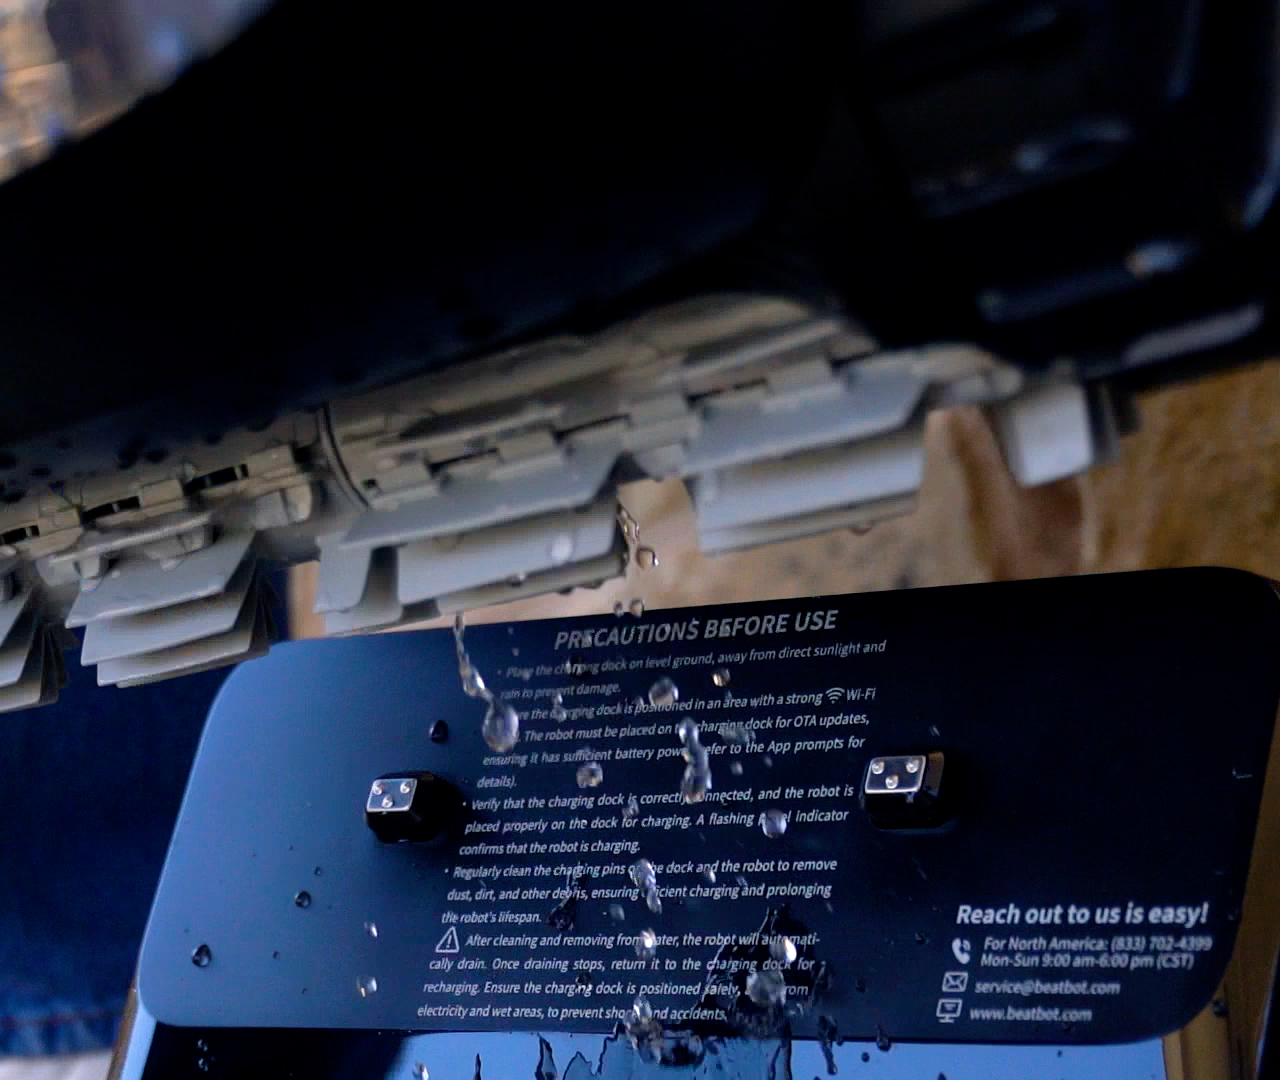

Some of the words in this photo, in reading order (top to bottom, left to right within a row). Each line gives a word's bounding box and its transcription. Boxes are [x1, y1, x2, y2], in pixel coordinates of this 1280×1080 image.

[553, 620, 700, 650] PRECAUTIONS
[704, 613, 790, 639] BEFORE
[795, 609, 839, 632] USE
[601, 658, 628, 671] dock
[629, 660, 643, 669] on
[645, 656, 671, 668] level
[672, 652, 715, 669] ground,
[717, 650, 747, 665] away
[749, 648, 776, 661] from
[778, 645, 811, 658] direct
[813, 642, 860, 657] sunlight
[863, 640, 887, 653] and
[576, 683, 620, 696] damage.
[596, 704, 622, 715] dock
[624, 702, 633, 714] is
[695, 695, 705, 709] in
[707, 700, 721, 709] an
[723, 698, 747, 708] area
[750, 694, 773, 707] with
[776, 697, 784, 705] a
[785, 692, 823, 706] strong
[847, 687, 876, 701] Wi-Fi
[524, 730, 542, 742] The
[544, 729, 573, 741] robot
[575, 728, 602, 740] must
[604, 726, 618, 738] be
[619, 724, 656, 739] placed
[657, 725, 672, 735] on
[745, 716, 772, 730] dock
[774, 715, 792, 729] for
[793, 716, 817, 728] OTA
[819, 713, 870, 729] updates,
[530, 753, 538, 764] it
[542, 752, 560, 763] has
[563, 748, 611, 761] sufficient
[615, 747, 654, 761] battery
[730, 743, 742, 754] to
[745, 741, 764, 753] the
[767, 740, 791, 757] App
[794, 738, 844, 754] prompts
[847, 735, 866, 749] for
[476, 775, 517, 789] details).
[471, 798, 501, 812] Verify
[503, 797, 524, 809] that
[528, 796, 546, 808] the
[548, 795, 594, 810] charging
[597, 793, 624, 806] dock
[628, 793, 637, 804] is
[640, 791, 687, 806] correctly
[758, 788, 780, 800] and
[784, 786, 804, 798] the
[807, 785, 840, 798] robot
[843, 784, 854, 797] is
[464, 820, 500, 835] placed
[502, 819, 548, 834] properly
[551, 821, 565, 830] on
[569, 818, 588, 829] the
[591, 816, 618, 828] dock
[621, 815, 638, 828] for
[641, 814, 692, 829] charging.
[695, 814, 705, 825] A
[709, 812, 755, 827] flashing
[795, 809, 849, 822] indicator
[459, 843, 504, 855] confirms
[506, 842, 527, 854] that
[529, 841, 547, 853] the
[549, 840, 578, 853] robot
[580, 841, 589, 852] is
[590, 839, 640, 854] charging.
[453, 866, 501, 880] Regularly
[503, 865, 531, 877] clean
[533, 864, 551, 876] the
[553, 863, 600, 878] charging
[602, 863, 626, 877] pins
[666, 860, 693, 874] dock
[696, 860, 718, 872] and
[721, 860, 740, 872] the
[742, 859, 774, 872] robot
[777, 861, 790, 872] to
[792, 860, 837, 871] remove
[447, 889, 472, 902] dust,
[475, 888, 496, 901] dirt,
[499, 888, 519, 899] and
[521, 887, 551, 899] other
[552, 887, 588, 900] debris,
[591, 887, 639, 901] ensuring
[689, 884, 739, 899] charging
[741, 884, 765, 896] and
[766, 882, 832, 899] prolonging
[441, 911, 459, 923] the
[460, 911, 497, 923] robot's
[499, 910, 542, 925] lifespan.
[956, 903, 1020, 924] Reach
[1024, 904, 1063, 924] out
[1067, 904, 1090, 924] to
[1095, 906, 1121, 924] us
[1125, 900, 1144, 924] is
[1148, 901, 1209, 928] easy!
[465, 934, 490, 946] After
[493, 934, 538, 949] cleaning
[540, 934, 562, 946] and
[563, 935, 614, 949] removing
[682, 934, 701, 945] the
[704, 933, 737, 945] robot
[739, 932, 759, 945] will
[983, 936, 1007, 950] For
[1008, 936, 1048, 950] North
[1049, 936, 1109, 950] America:
[429, 958, 454, 972] cally
[457, 958, 486, 970] drain.
[492, 958, 520, 970] Once
[524, 957, 569, 973] draining
[572, 958, 606, 972] stops,
[610, 959, 646, 970] return
[651, 958, 661, 970] it
[664, 959, 677, 970] to
[682, 958, 701, 970] the
[762, 957, 791, 970] dock
[796, 957, 815, 970] for
[980, 953, 1039, 967] Mon-Sun
[1041, 953, 1071, 967] 9:00
[1129, 956, 1154, 971] pm
[1156, 953, 1195, 970] (CST)
[423, 982, 480, 996] recharging.
[484, 982, 520, 993] Ensure
[524, 982, 541, 993] the
[544, 982, 592, 996] charging
[595, 981, 623, 994] dock
[626, 982, 636, 994] is
[639, 982, 701, 996] positioned
[974, 979, 1121, 997] service@beatbot.com
[417, 1005, 468, 1019] electricity
[469, 1005, 490, 1017] and
[492, 1006, 512, 1017] wet
[513, 1007, 544, 1020] areas,
[547, 1006, 558, 1018] to
[560, 1007, 605, 1020] prevent
[969, 1005, 1093, 1022] www.beatbot.com
